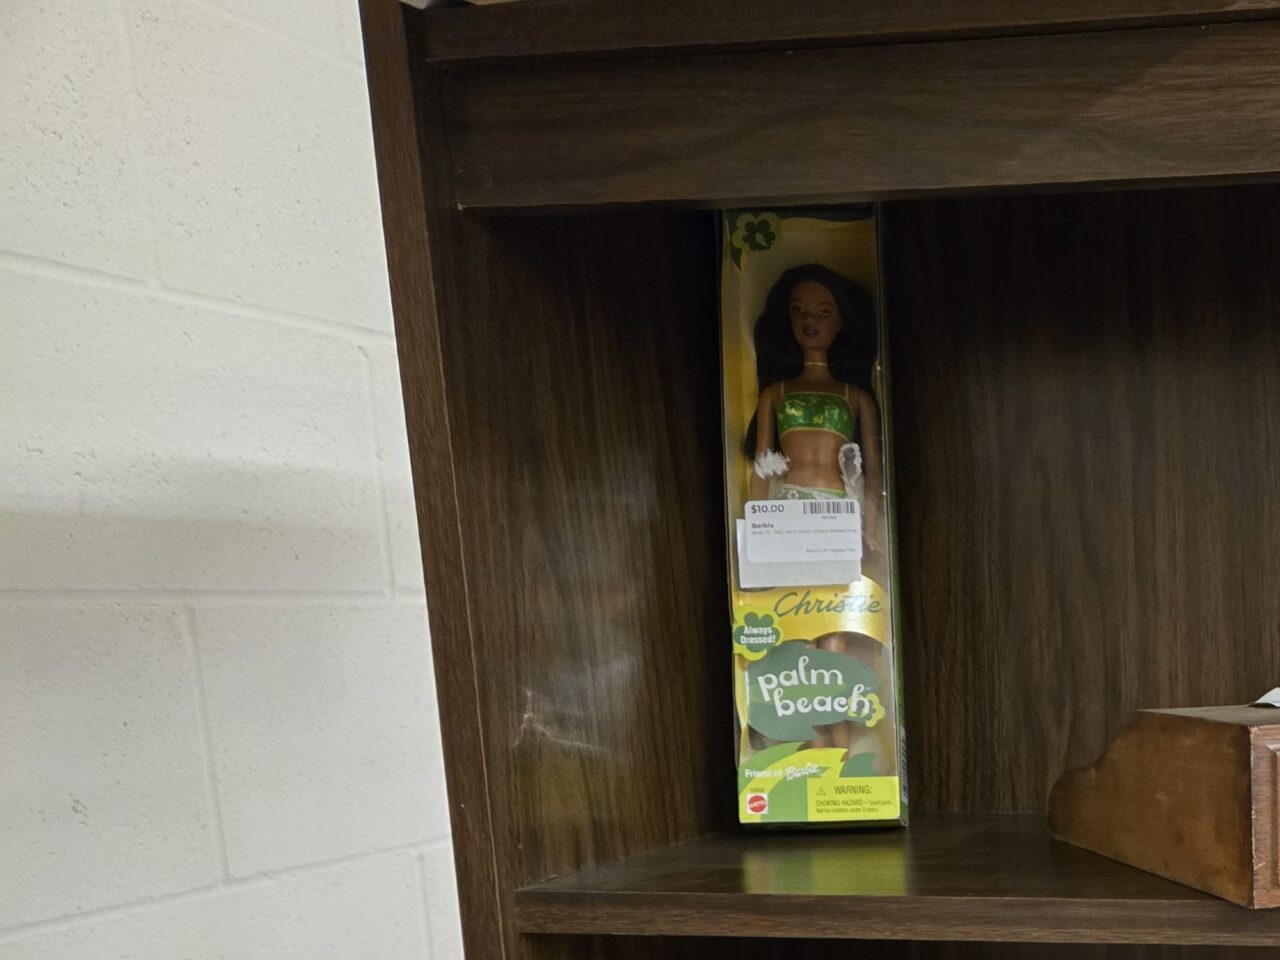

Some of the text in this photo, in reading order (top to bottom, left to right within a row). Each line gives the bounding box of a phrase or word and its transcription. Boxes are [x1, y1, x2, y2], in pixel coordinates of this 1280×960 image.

[751, 504, 785, 514] $10.00
[774, 590, 885, 617] Christie
[743, 625, 773, 636] Always
[740, 634, 776, 644] Dressed!
[757, 655, 843, 701] palm
[773, 684, 870, 717] beach
[834, 785, 873, 794] WARNING:
